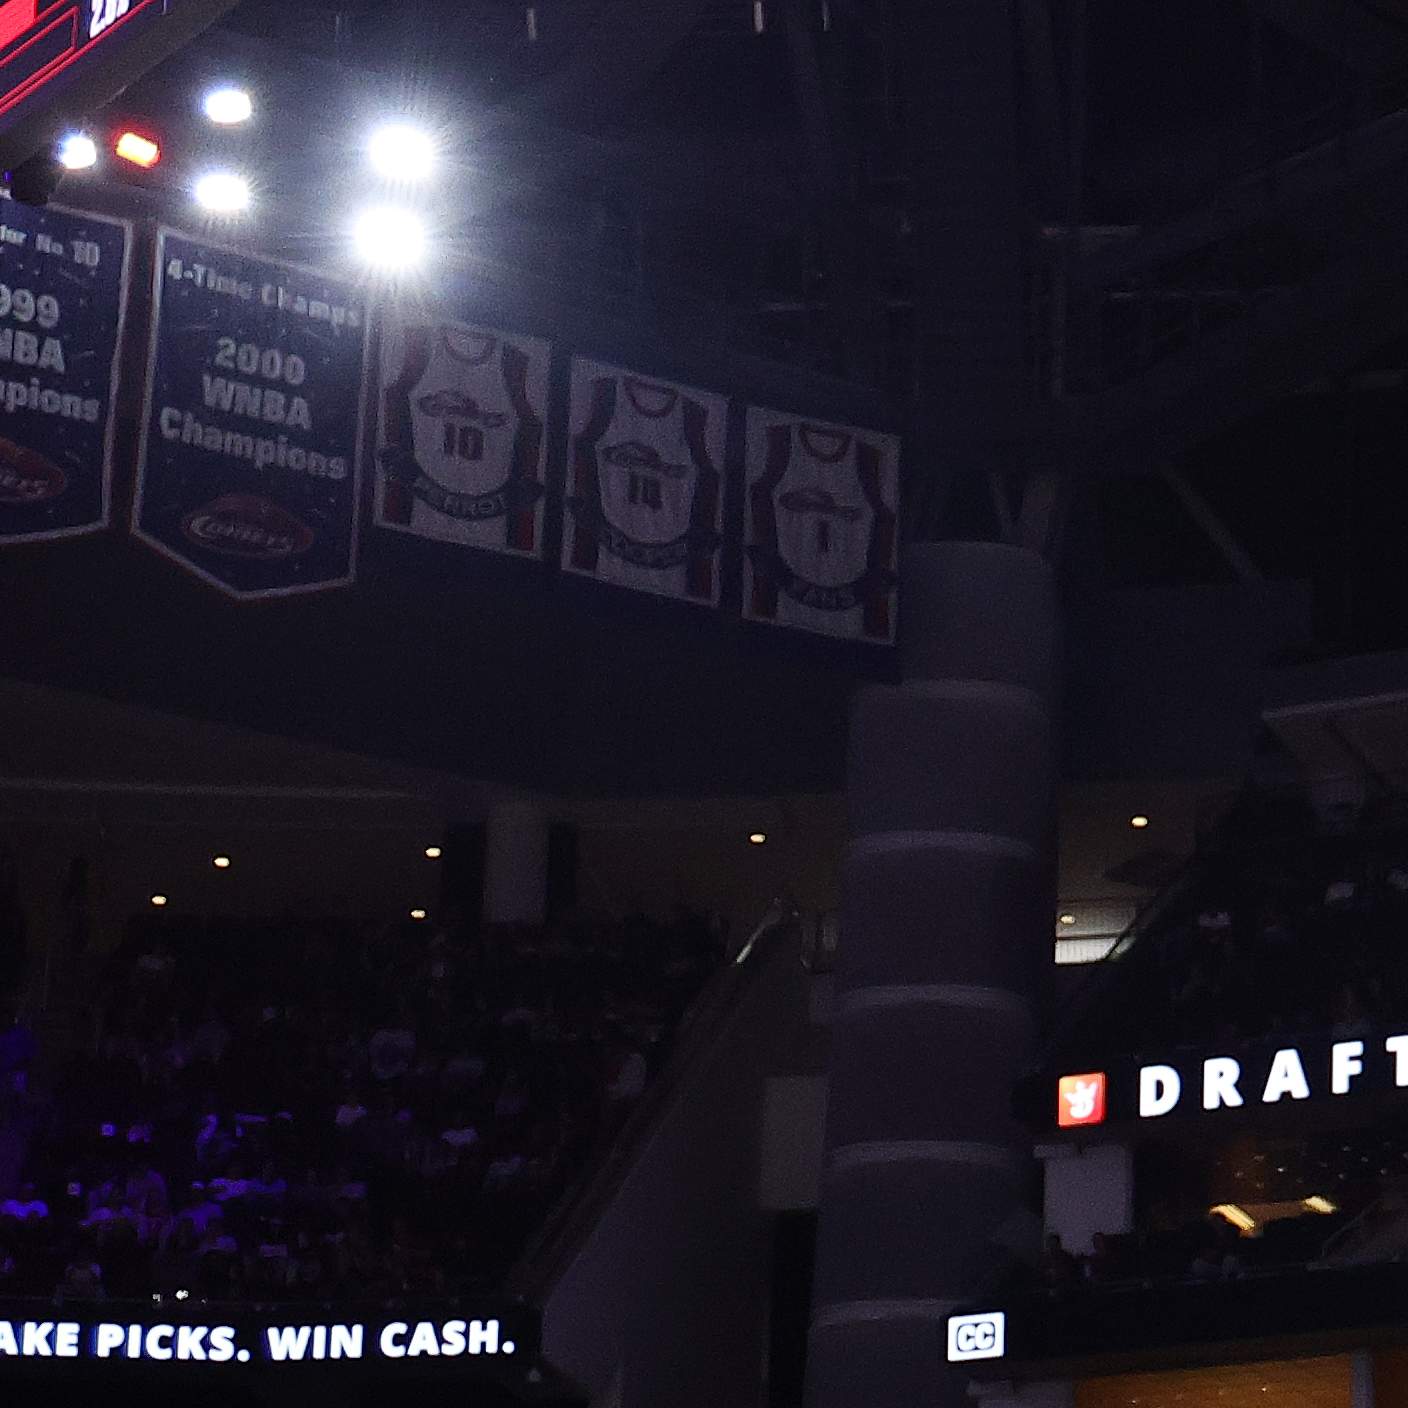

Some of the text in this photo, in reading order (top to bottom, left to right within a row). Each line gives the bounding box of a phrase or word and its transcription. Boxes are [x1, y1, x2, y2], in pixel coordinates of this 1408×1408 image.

[215, 337, 305, 387] 2000
[202, 374, 311, 431] WNBA
[160, 407, 348, 480] Champions
[0, 1319, 515, 1362] AKE PICKS. WIN CASH.
[955, 1320, 996, 1353] CC
